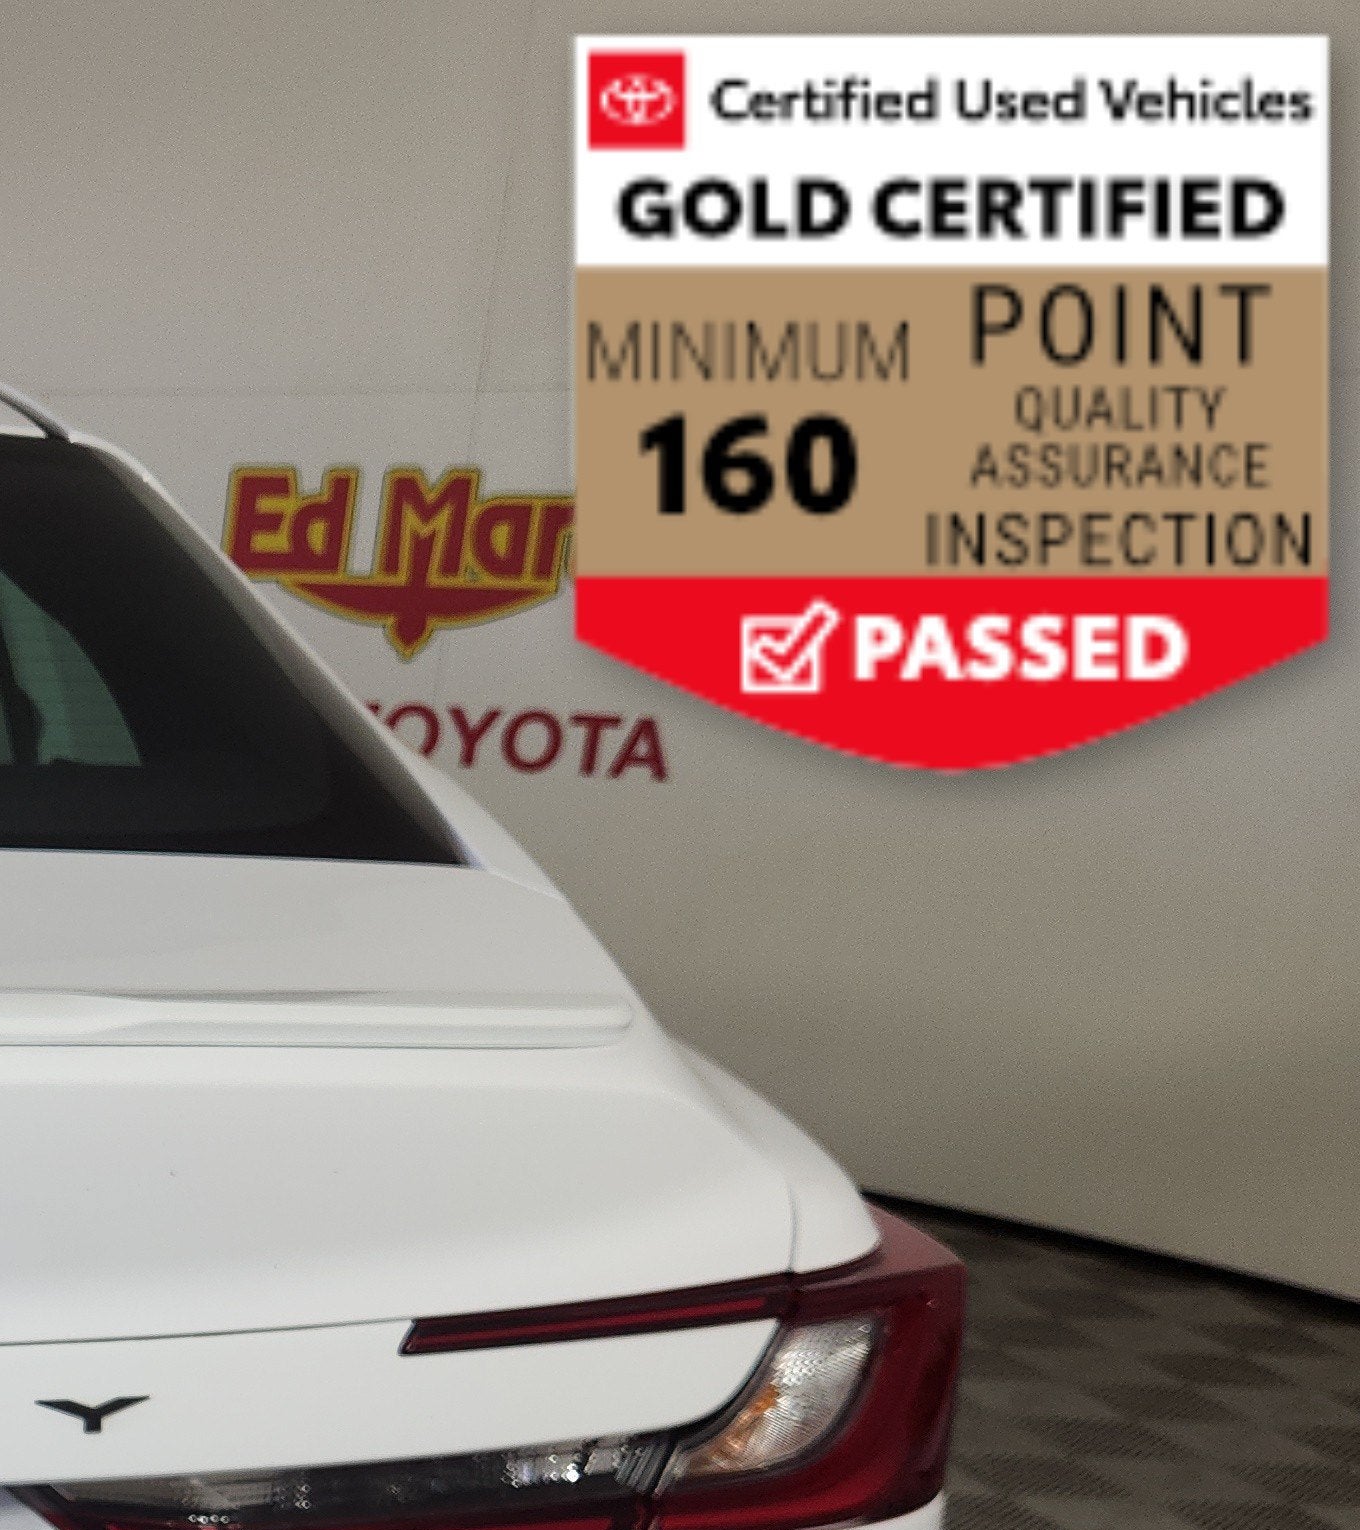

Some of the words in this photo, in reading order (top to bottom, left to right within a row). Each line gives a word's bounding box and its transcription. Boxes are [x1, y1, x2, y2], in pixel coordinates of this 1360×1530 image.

[220, 466, 360, 580] Ed
[372, 466, 577, 586] Mar
[365, 702, 669, 781] OYOTA
